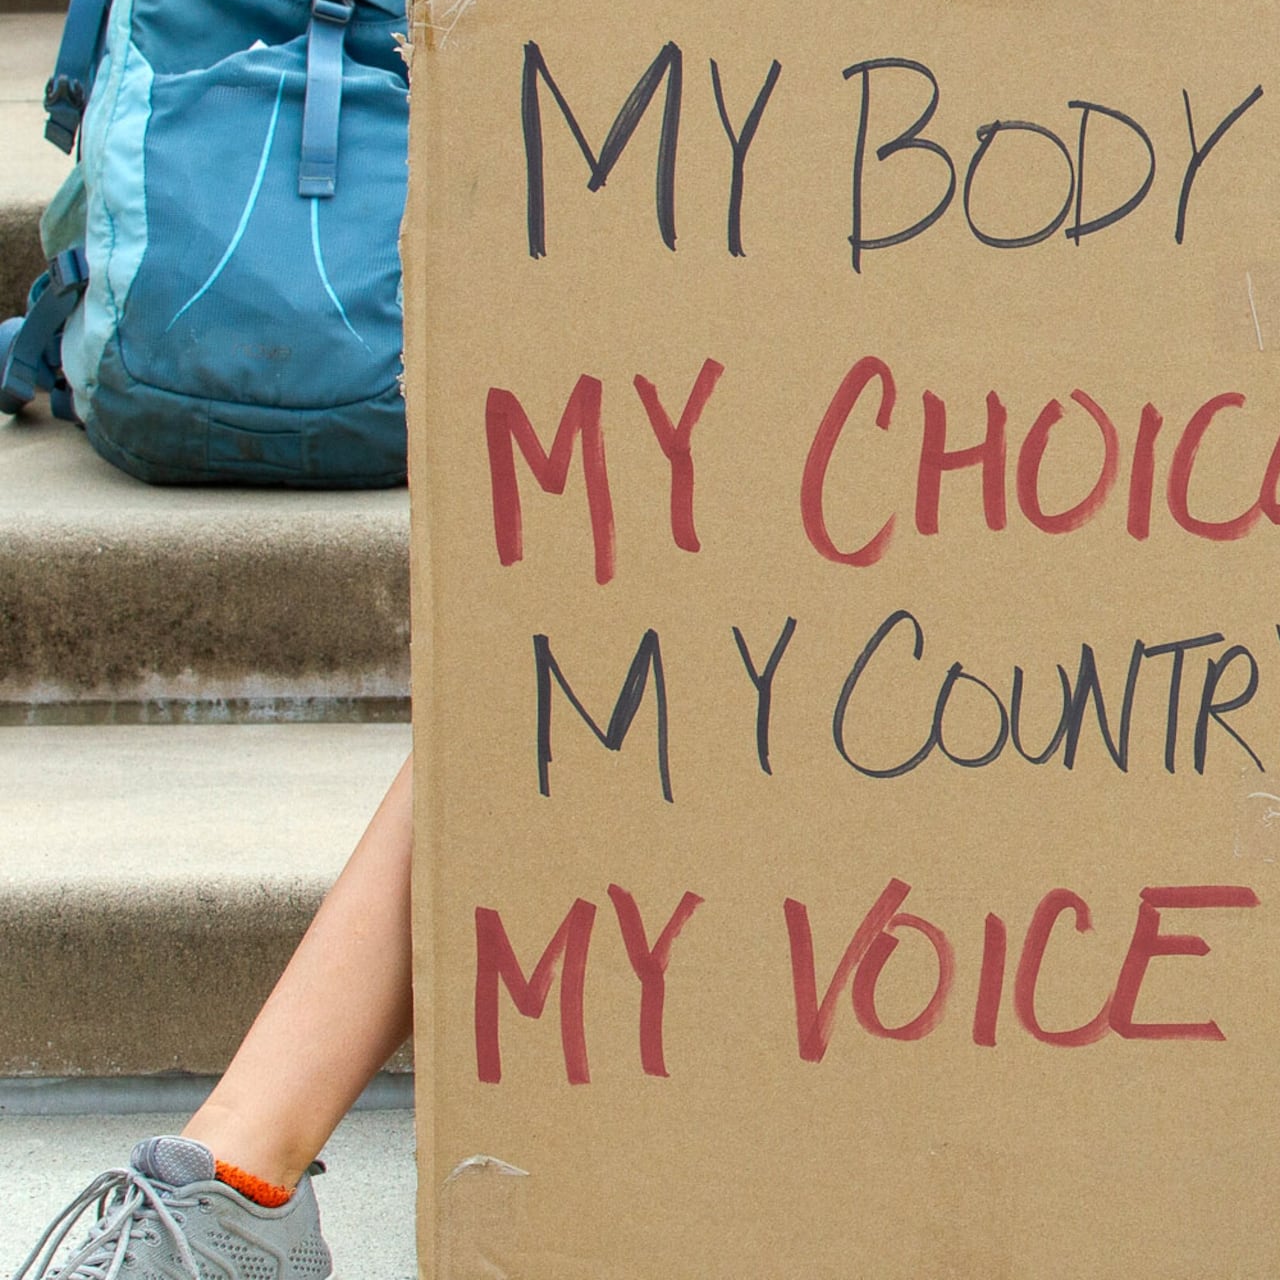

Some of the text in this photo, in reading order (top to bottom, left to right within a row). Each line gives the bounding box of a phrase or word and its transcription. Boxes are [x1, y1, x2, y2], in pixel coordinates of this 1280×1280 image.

[522, 40, 1264, 274] MY BODY
[486, 358, 725, 586] MY
[532, 616, 798, 804] MY
[475, 877, 1262, 1085] MY VOICE
